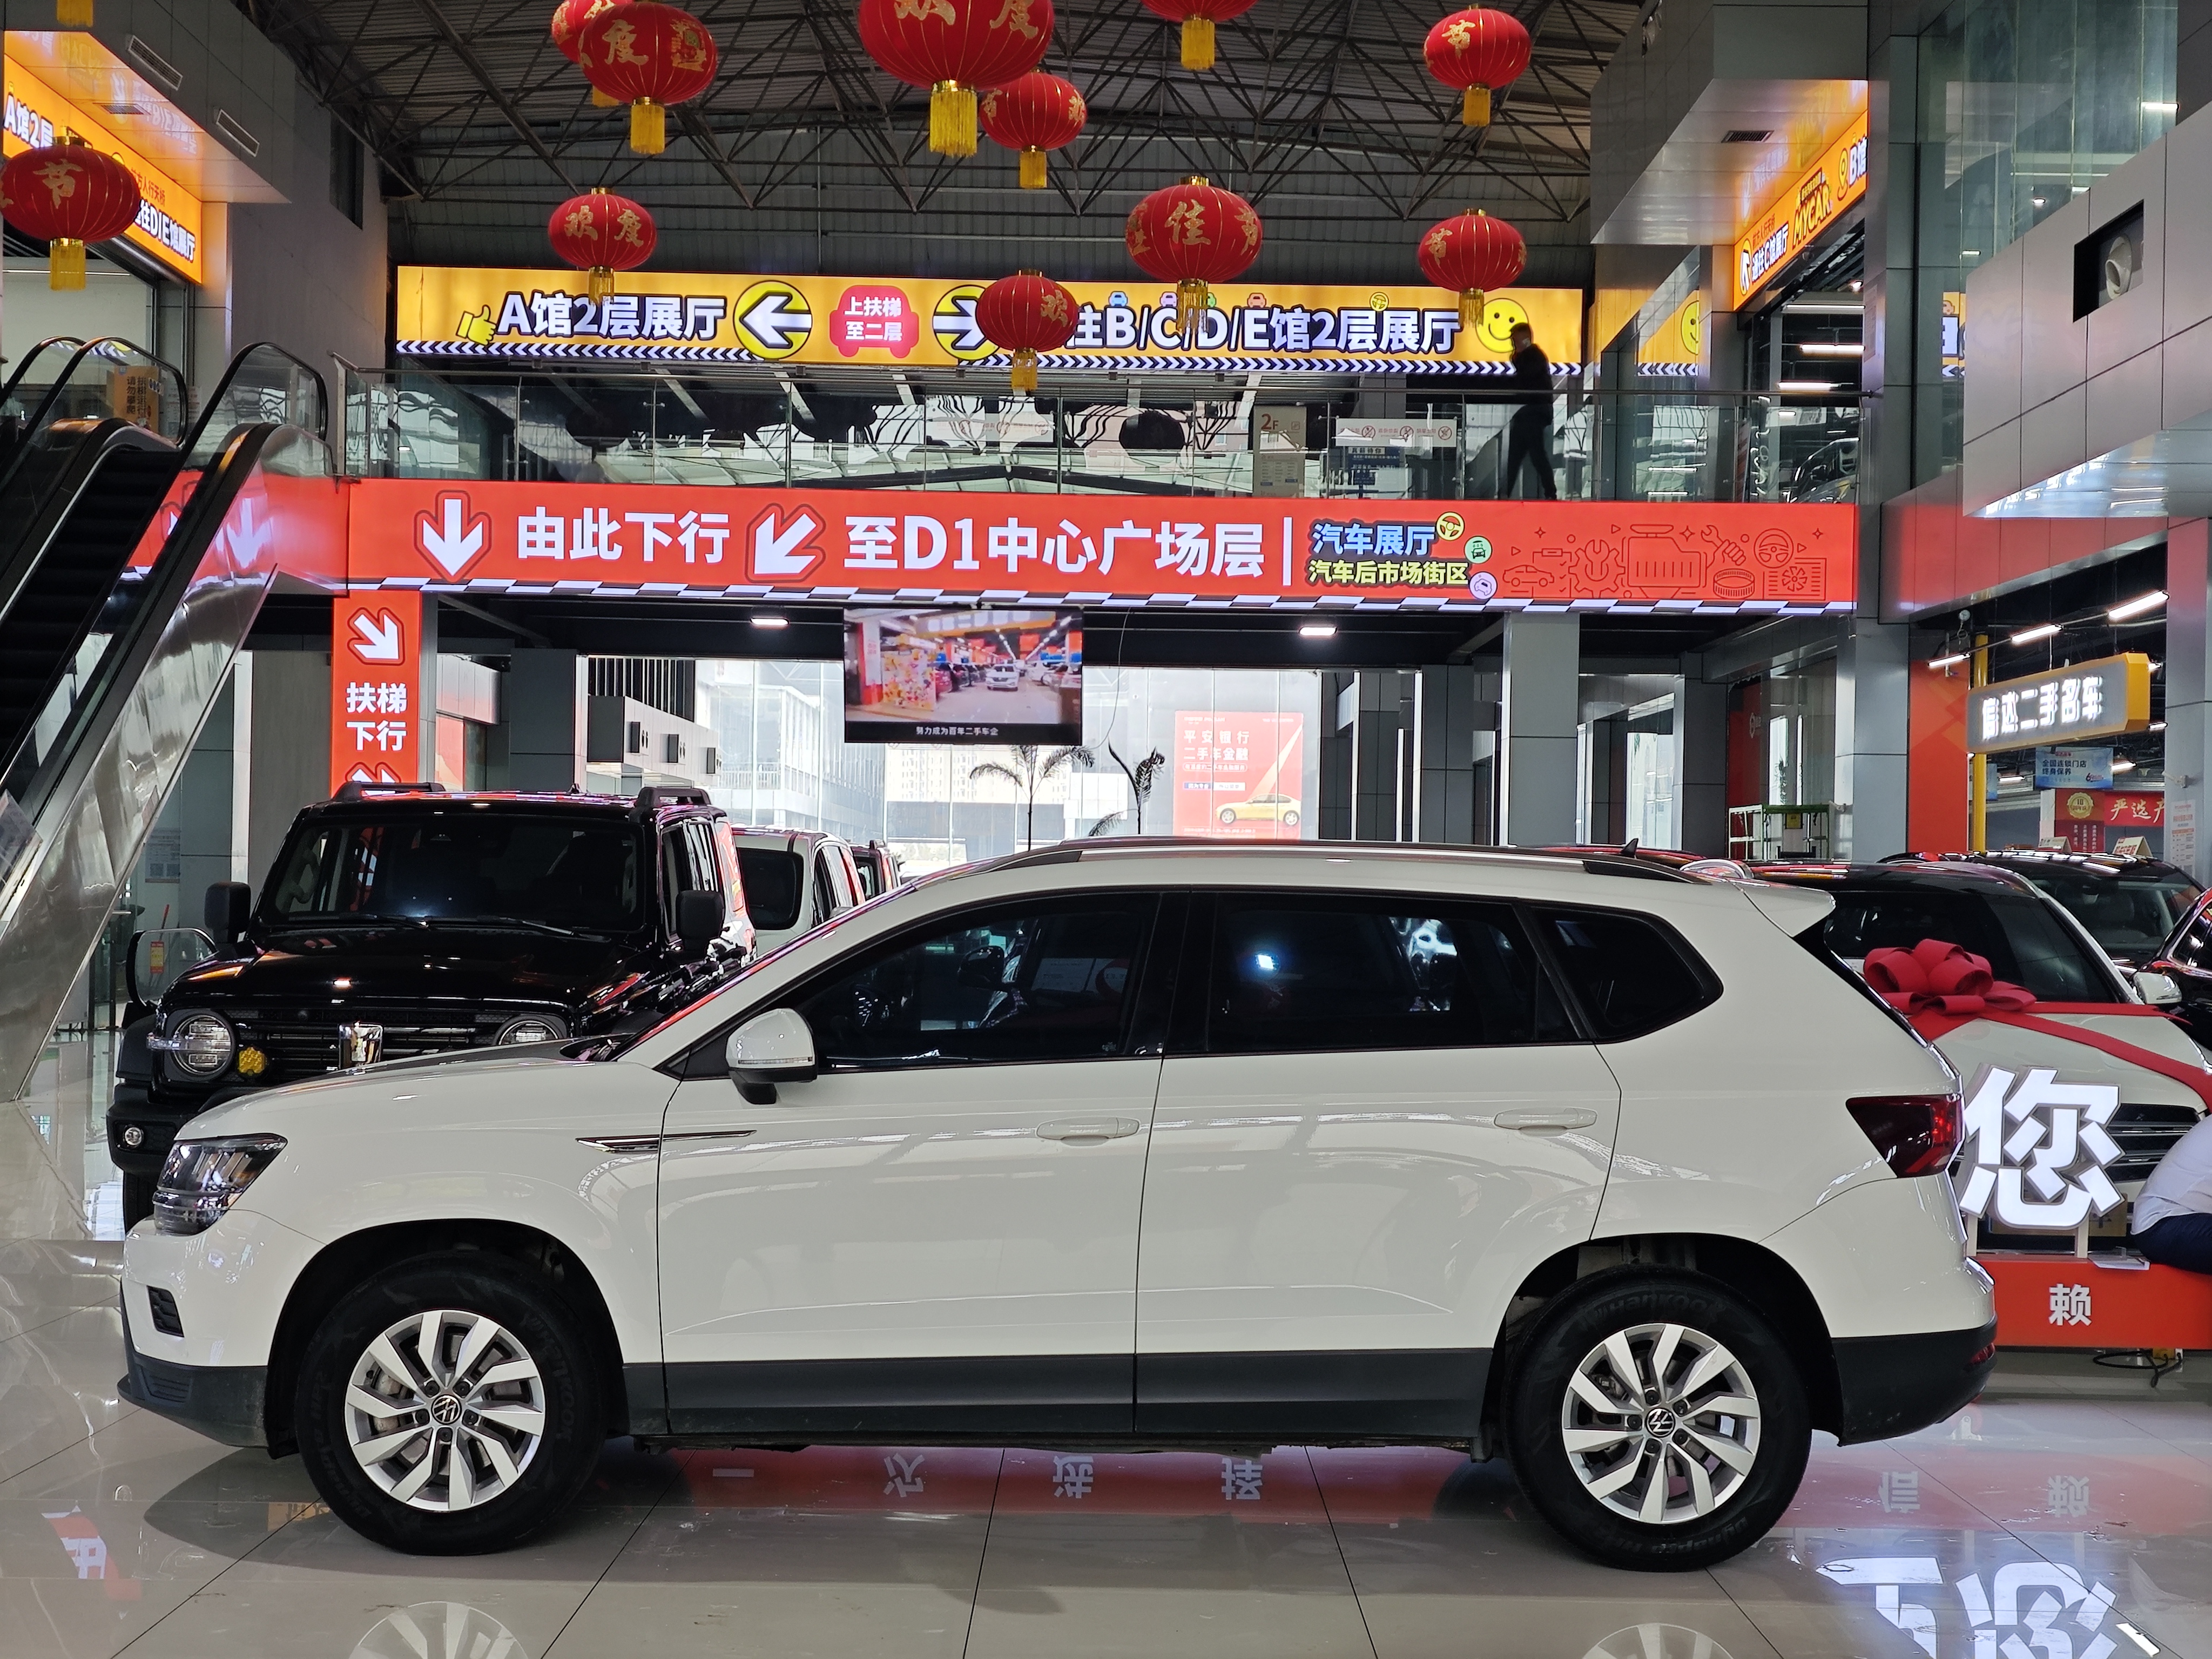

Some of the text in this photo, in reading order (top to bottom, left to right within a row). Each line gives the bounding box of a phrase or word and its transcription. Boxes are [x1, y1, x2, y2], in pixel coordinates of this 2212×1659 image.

[1793, 184, 1831, 249] MYCAR
[498, 292, 725, 340] A馆2层展厅
[844, 295, 902, 318] 上扶梯
[845, 321, 903, 342] 至二层
[1261, 414, 1279, 430] 2F
[517, 506, 730, 563] 由此下行
[844, 515, 1264, 577] 至D1中心广场层
[1311, 523, 1437, 556] 汽车展厅
[1309, 560, 1469, 585] 汽车后市场街区
[346, 682, 407, 714] 扶梯
[346, 720, 407, 751] 下行
[916, 726, 999, 736] 努力成为百年二手车企
[1183, 730, 1250, 744] 平安银行
[2042, 759, 2087, 767] 全国连锁门店
[1960, 1066, 2126, 1230] 您
[2048, 1283, 2093, 1327] 赖
